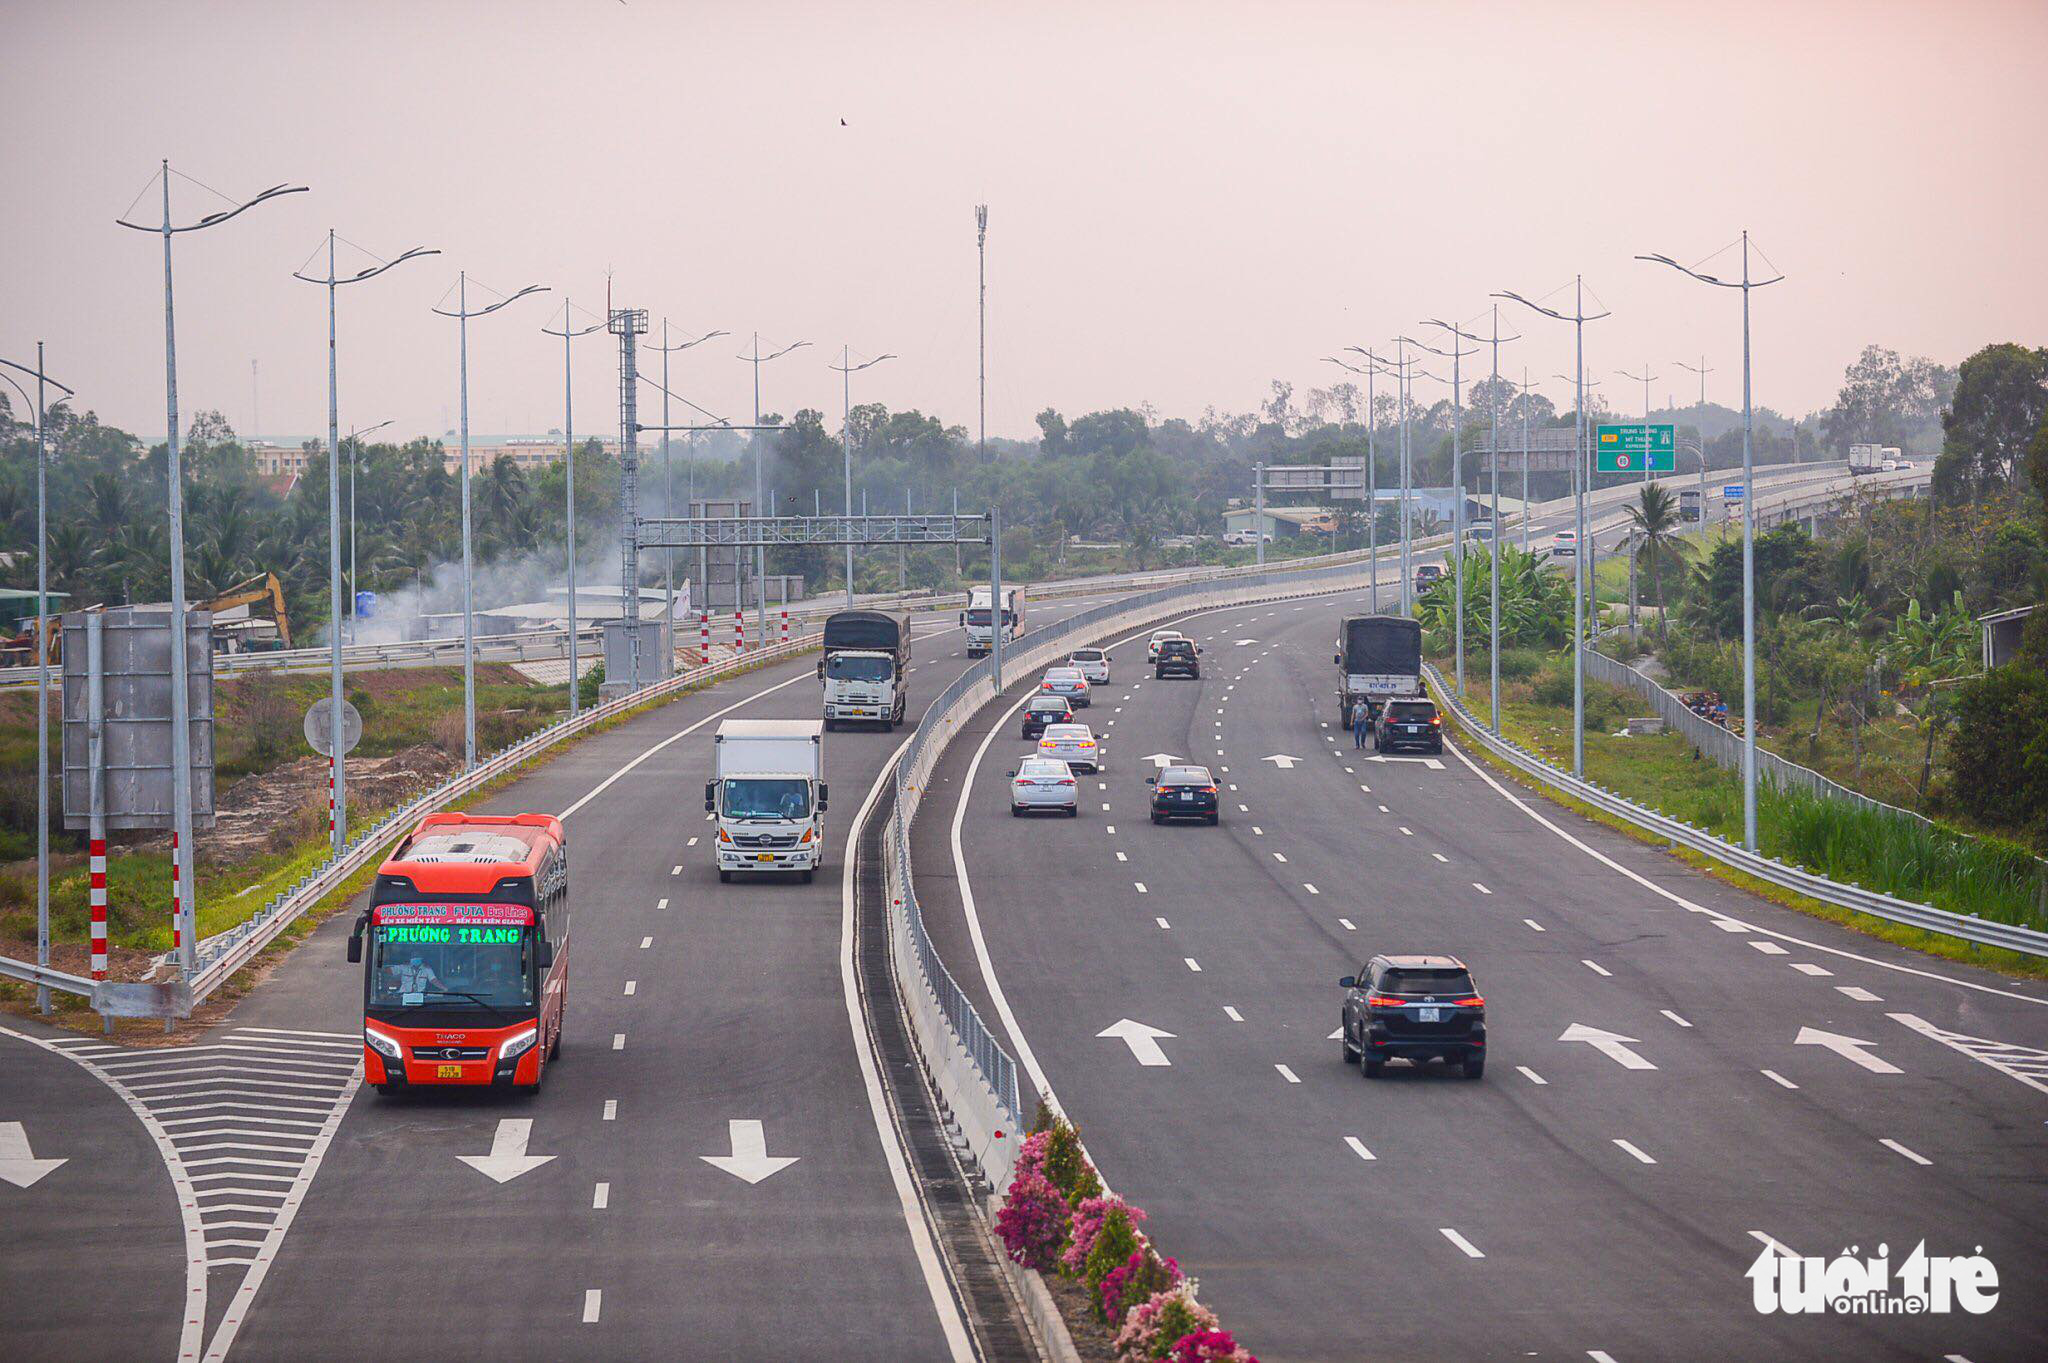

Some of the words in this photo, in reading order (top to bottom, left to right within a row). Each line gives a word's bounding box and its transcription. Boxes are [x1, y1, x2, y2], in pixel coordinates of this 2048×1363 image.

[417, 905, 447, 917] TRANG
[454, 905, 484, 917] FUTA
[488, 906, 504, 917] Bus
[504, 906, 528, 918] Lines
[387, 924, 451, 943] PHƯƠNG
[458, 928, 520, 943] TRANG
